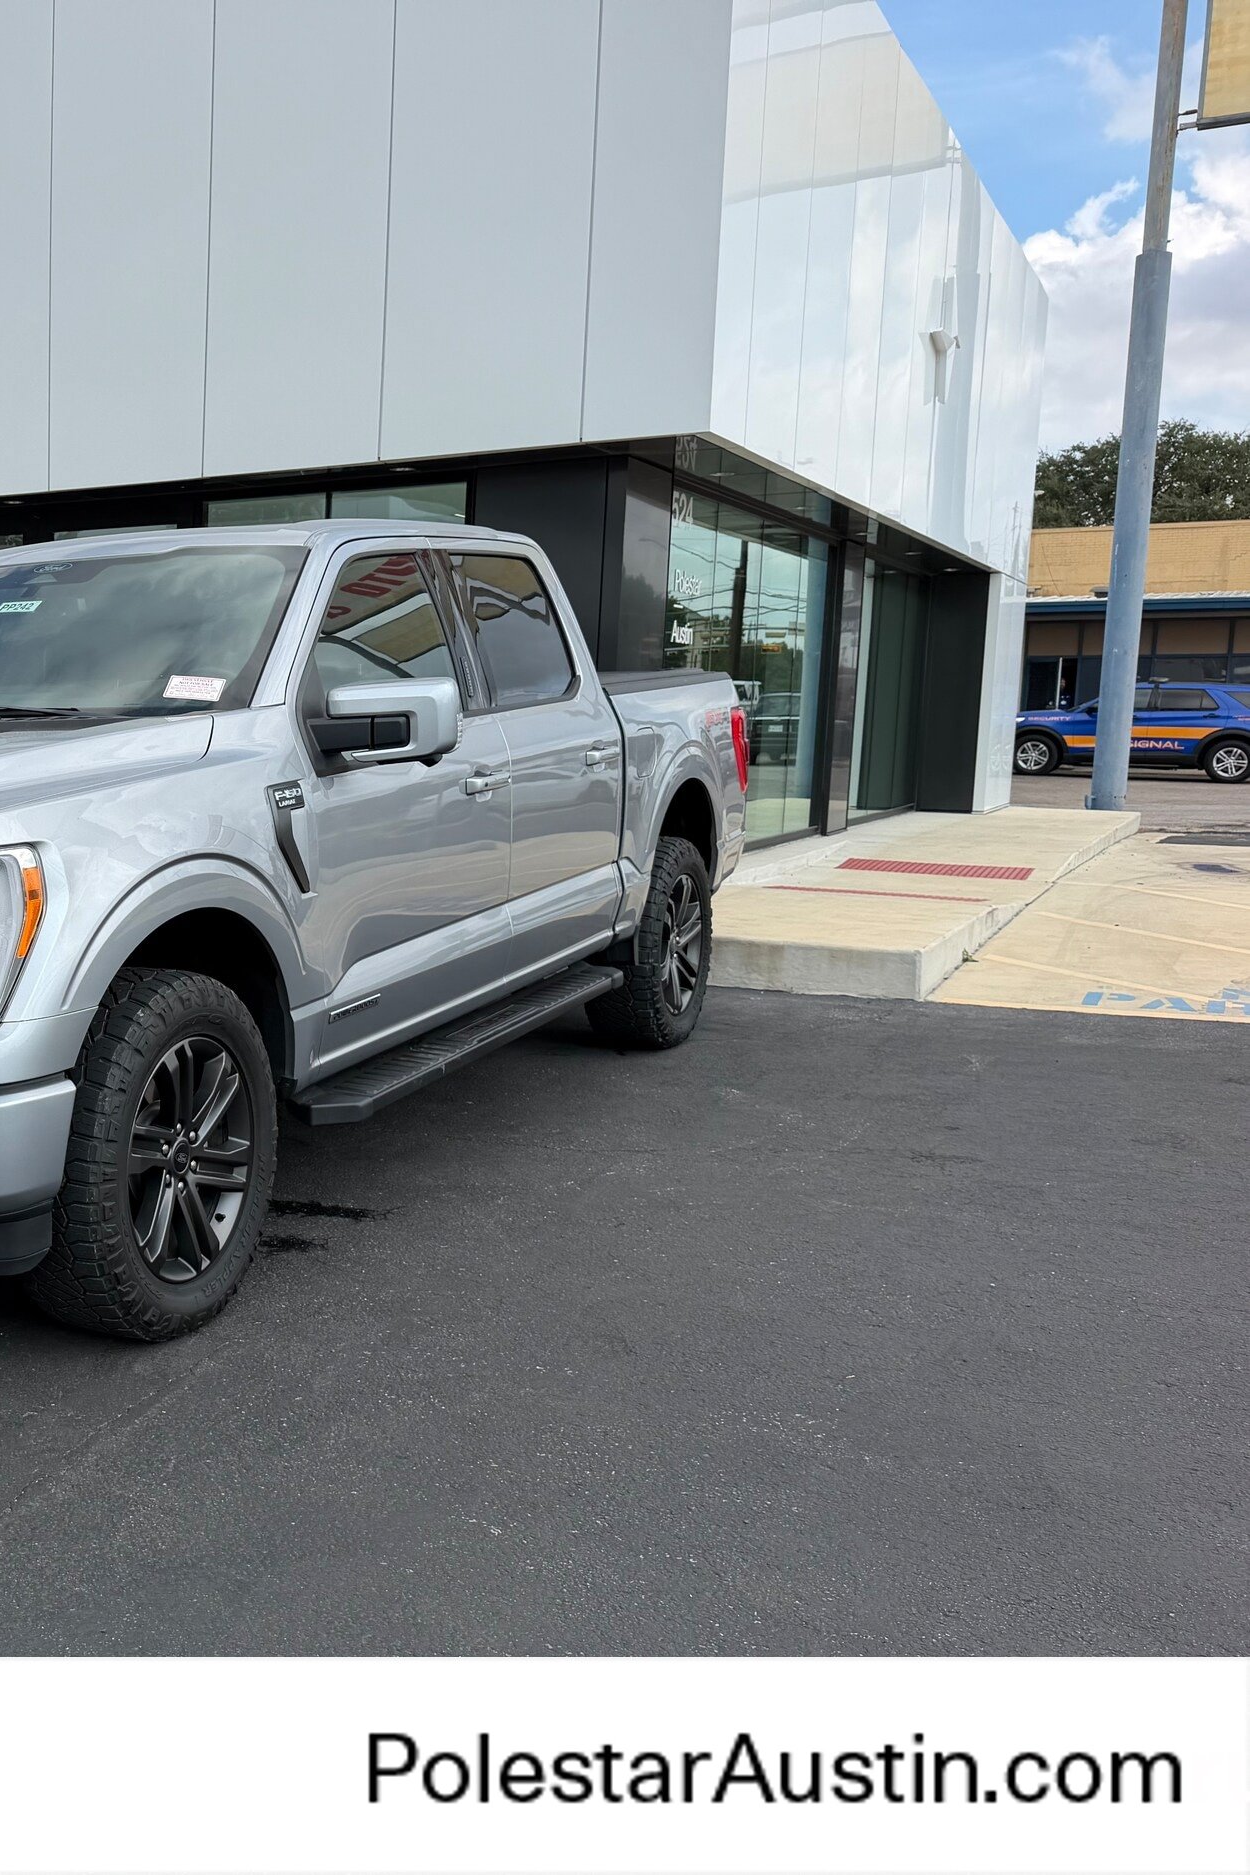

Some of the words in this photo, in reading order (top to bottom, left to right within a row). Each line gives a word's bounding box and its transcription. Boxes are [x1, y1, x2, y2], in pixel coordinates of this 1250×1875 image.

[674, 569, 703, 596] Polestar
[0, 603, 34, 612] PP242
[670, 619, 694, 645] Austin
[275, 788, 302, 800] F-150
